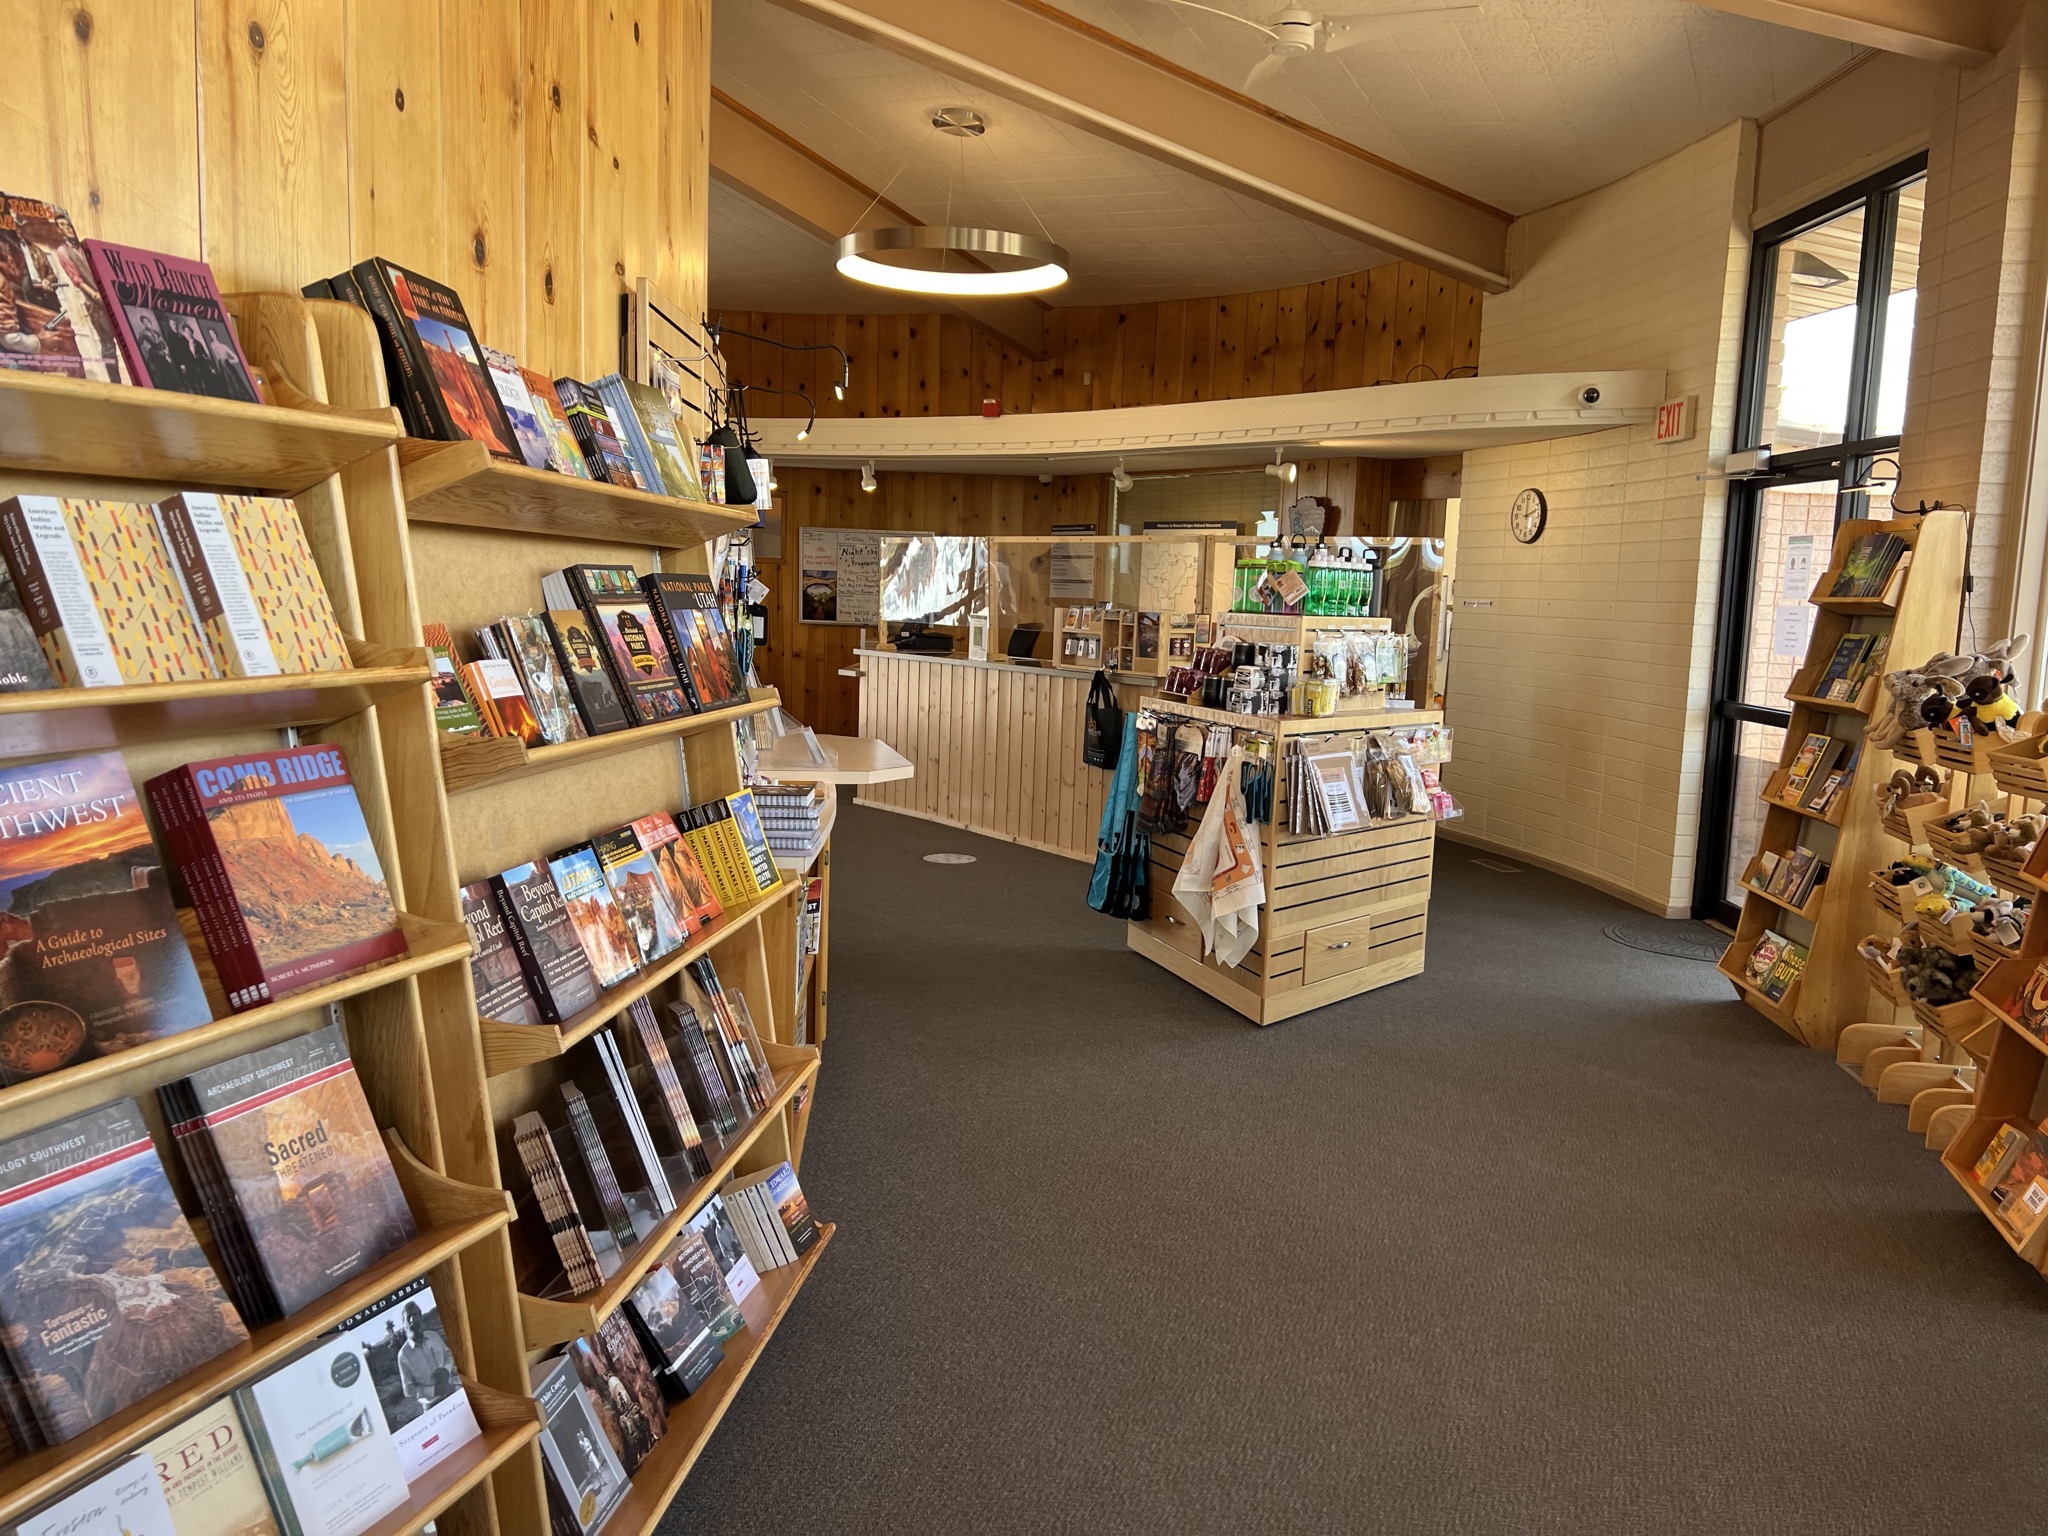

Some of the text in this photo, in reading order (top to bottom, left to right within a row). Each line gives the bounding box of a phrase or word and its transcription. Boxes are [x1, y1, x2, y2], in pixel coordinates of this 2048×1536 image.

[9, 199, 54, 219] TALES
[101, 248, 212, 300] WILD BUNCH
[113, 279, 223, 321] Women
[1658, 401, 1683, 439] EXIT
[27, 507, 58, 516] American
[191, 504, 217, 512] American
[10, 512, 31, 566] American Indian
[174, 508, 195, 559] American Indian
[841, 547, 863, 560] Night
[661, 581, 713, 593] NATIONAL PARKS
[694, 592, 718, 608] UTAH
[651, 588, 690, 684] NATIONAL PARKS UTAH
[196, 751, 345, 797] COMB RIDGE
[152, 790, 170, 830] MCPHERSON
[162, 786, 180, 827] MCPHERSON
[173, 781, 190, 822] MCPHERSON
[184, 777, 201, 818] MCPHERSON
[235, 794, 247, 802] ITS
[247, 790, 268, 799] PEOPLE
[702, 835, 725, 892] NATIONAL PARKS
[714, 830, 739, 888] NATIONAL PARKS
[728, 826, 751, 884] NATIONAL PARKS
[748, 844, 767, 857] NATIONAL
[750, 855, 762, 866] PARKS
[755, 862, 768, 875] UNITED
[757, 871, 771, 883] STATES
[521, 875, 555, 906] Beyond
[567, 880, 604, 900] NATIONAL PARKS
[463, 900, 490, 924] yond
[485, 914, 505, 937] Reef
[497, 889, 530, 957] Beyond Capitol Reef
[520, 898, 554, 923] Capitol
[535, 917, 561, 932] South-Central
[36, 927, 104, 953] A Guide to
[41, 927, 167, 969] Archaeological Sites
[271, 958, 334, 983] ROBERT MCPHERSON
[1774, 962, 1799, 982] BUTT
[207, 1057, 294, 1097] ARCHAEOLOGY SOUTHWEST
[265, 1056, 327, 1090] magazine
[29, 1135, 86, 1163] SOUTHWEST
[43, 1128, 136, 1174] magazine
[263, 1120, 328, 1166] Sacred
[273, 1145, 333, 1180] THREATENED
[770, 1167, 791, 1188] EDWARD
[678, 1238, 703, 1262] BEYOND THE
[682, 1247, 706, 1270] HUNDREDTH
[690, 1255, 710, 1274] MERIDIAN
[43, 1306, 85, 1328] Tortuous
[338, 1277, 427, 1331] EDWARD ABBEY
[39, 1306, 108, 1348] Fantastic
[600, 1316, 615, 1337] HOLE
[607, 1331, 623, 1352] ROCK
[550, 1374, 566, 1393] Canyon
[399, 1425, 430, 1447] Serpents
[438, 1400, 466, 1421] Paradise
[155, 1424, 233, 1484] RED
[171, 1478, 183, 1489] AND
[182, 1466, 206, 1485] PATIENCE
[212, 1457, 222, 1466] THE
[222, 1444, 239, 1460] DESERT
[178, 1452, 243, 1499] TEMPEST WILLIAMS
[42, 1503, 108, 1536] Erosion
